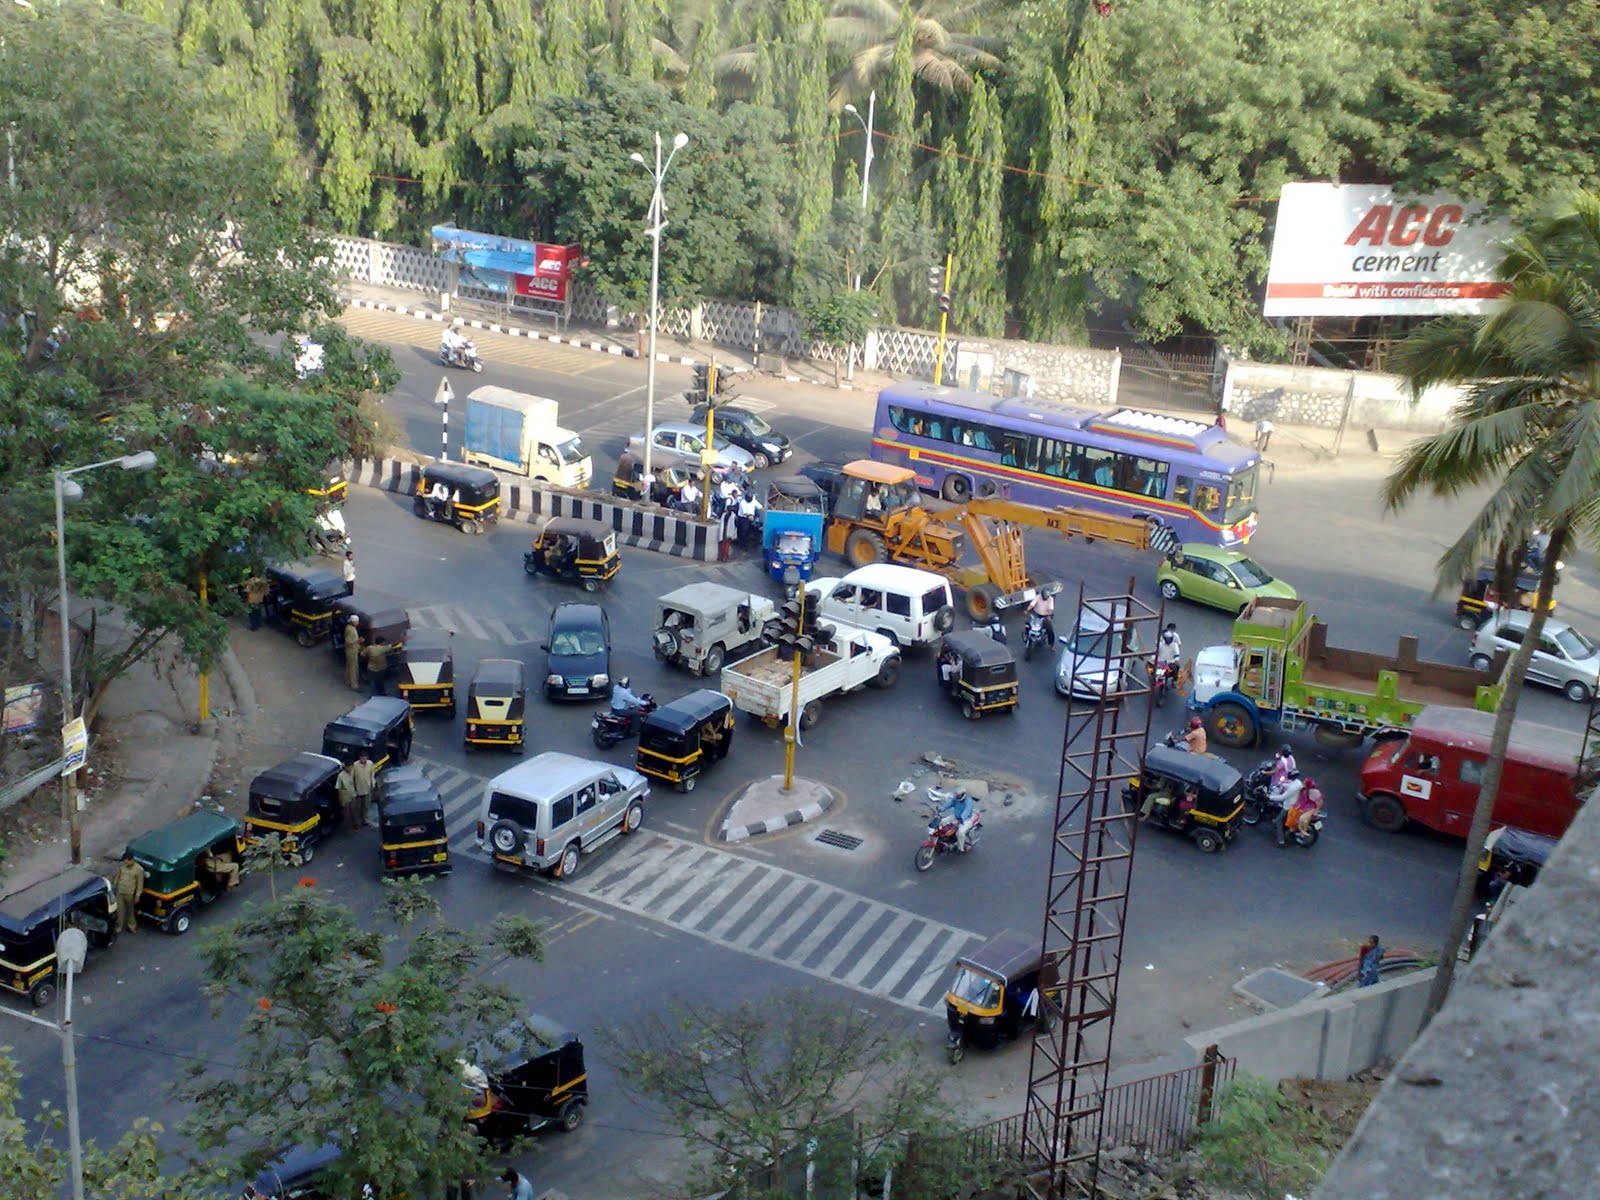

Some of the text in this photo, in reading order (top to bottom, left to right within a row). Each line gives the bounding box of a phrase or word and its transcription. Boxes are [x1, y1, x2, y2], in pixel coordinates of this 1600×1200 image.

[1344, 204, 1462, 246] ACC
[1352, 251, 1441, 271] cement
[529, 276, 558, 291] ACC
[1359, 284, 1388, 298] with
[1391, 284, 1461, 298] confidence
